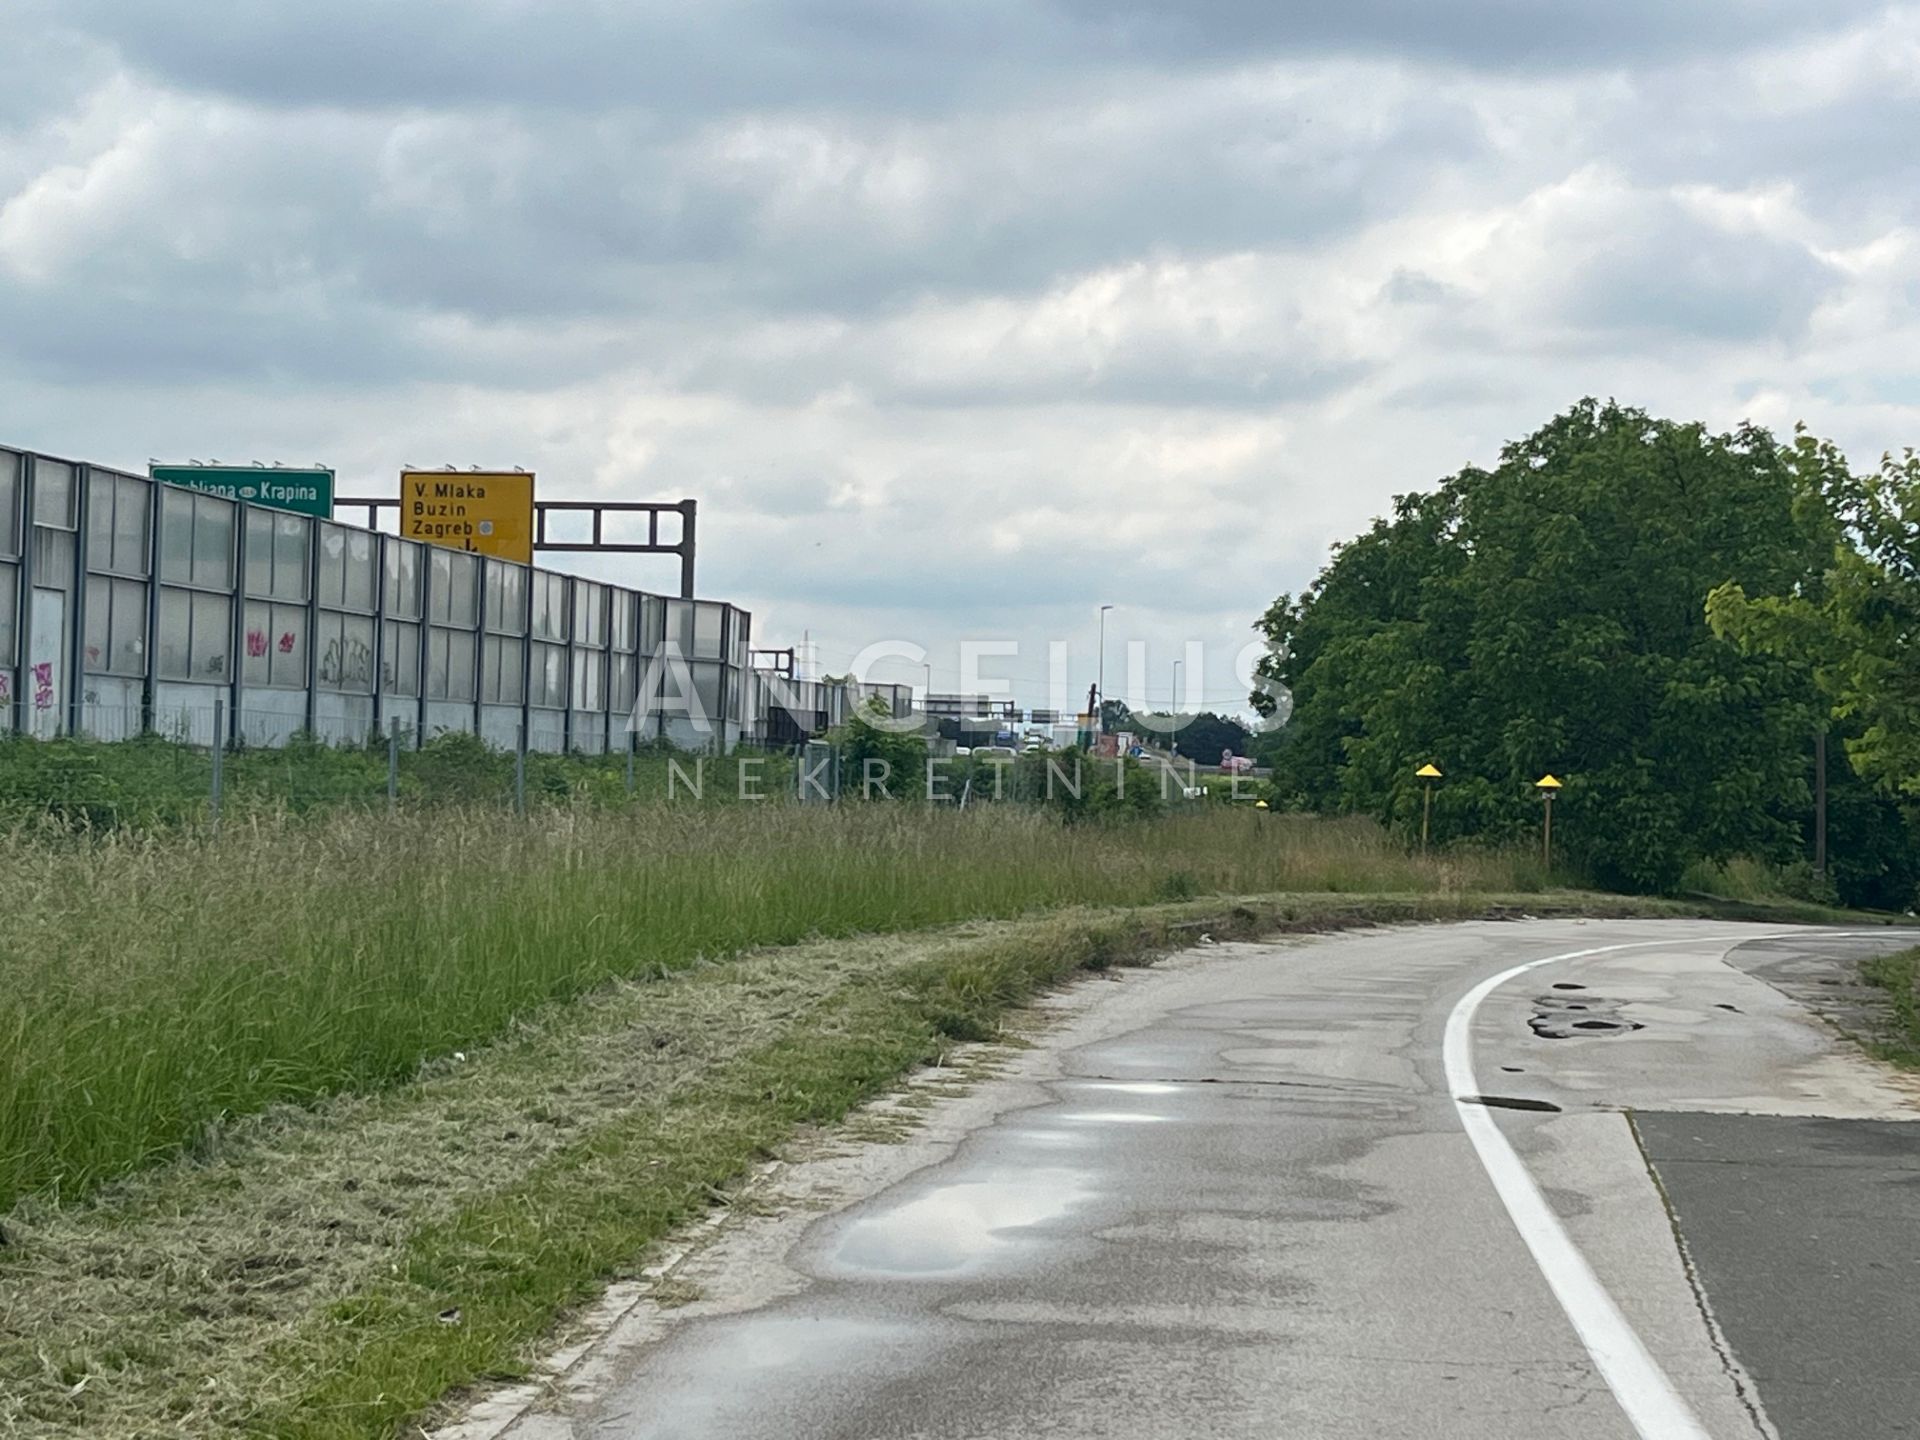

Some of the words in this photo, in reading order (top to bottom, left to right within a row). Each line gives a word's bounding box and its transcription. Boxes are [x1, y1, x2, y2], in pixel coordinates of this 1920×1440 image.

[261, 482, 317, 503] Krapina
[414, 482, 428, 498] V.
[435, 482, 486, 498] Mlaka
[414, 501, 466, 516] Buzin
[413, 520, 473, 538] Zagreb
